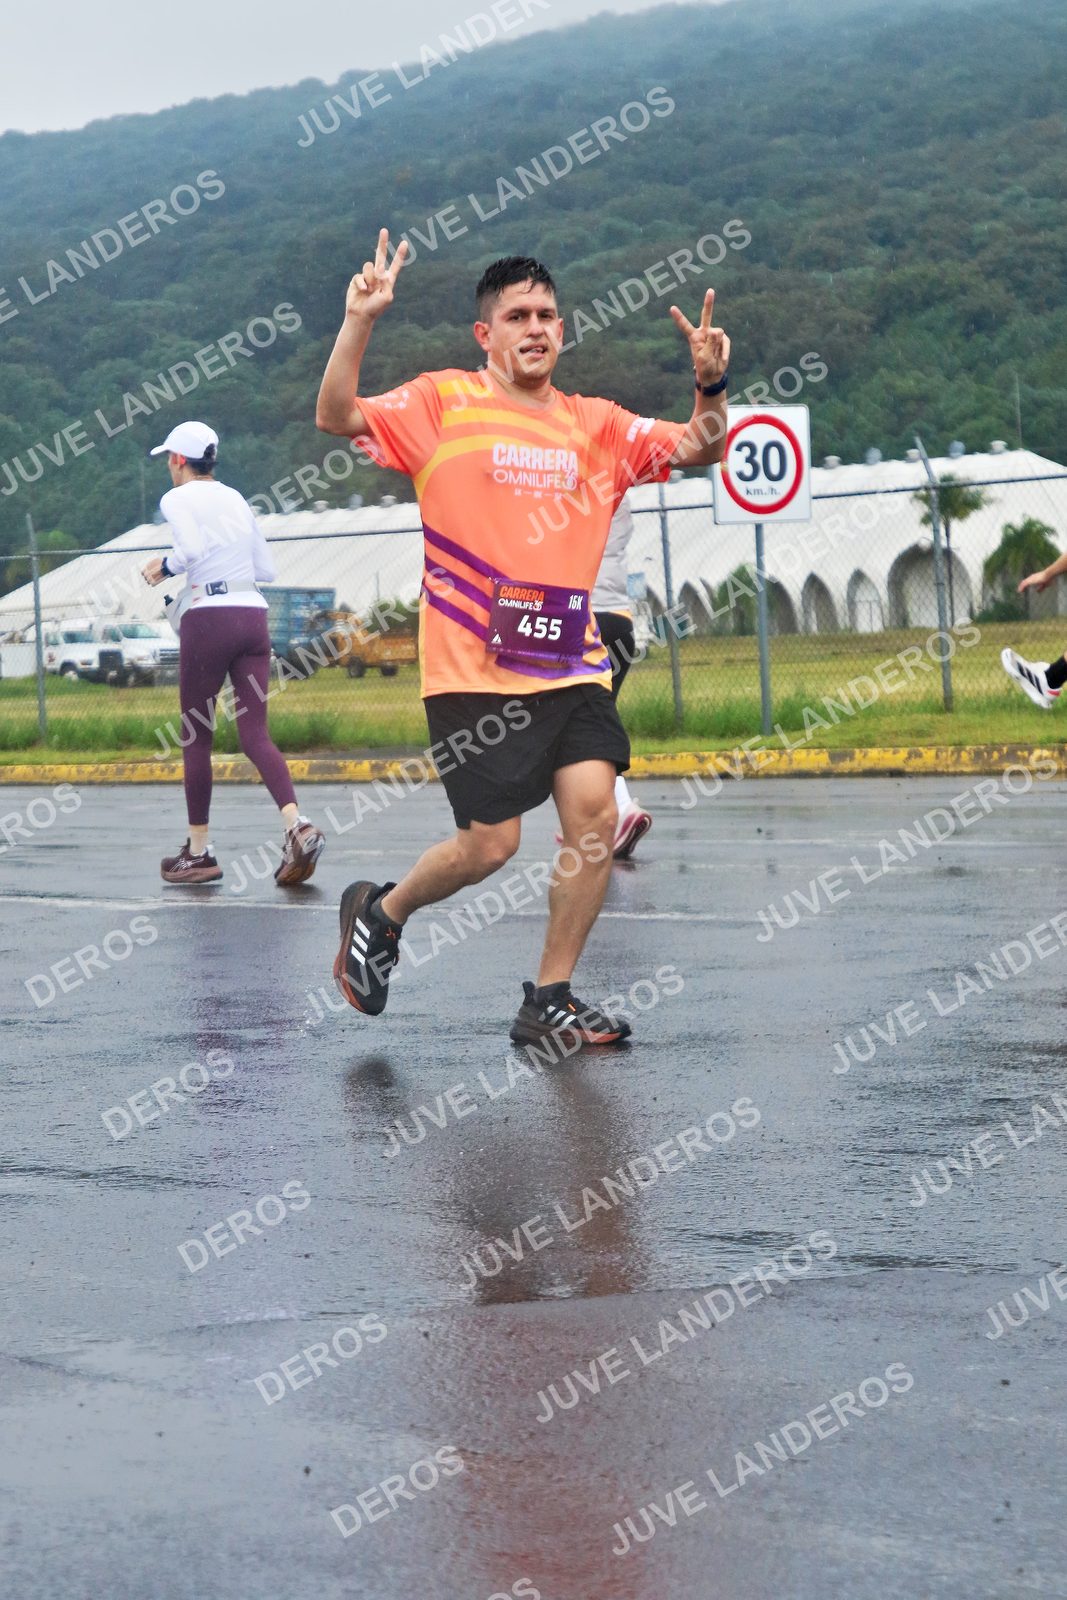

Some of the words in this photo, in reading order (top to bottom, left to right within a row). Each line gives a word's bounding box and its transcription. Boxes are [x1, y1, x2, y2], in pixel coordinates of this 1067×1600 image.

[492, 442, 578, 472] CARRERA
[735, 440, 787, 482] 30
[493, 469, 562, 489] OMNILIFE
[498, 598, 533, 610] OMNILIFE
[500, 585, 545, 602] CARRERA
[517, 614, 563, 641] 455
